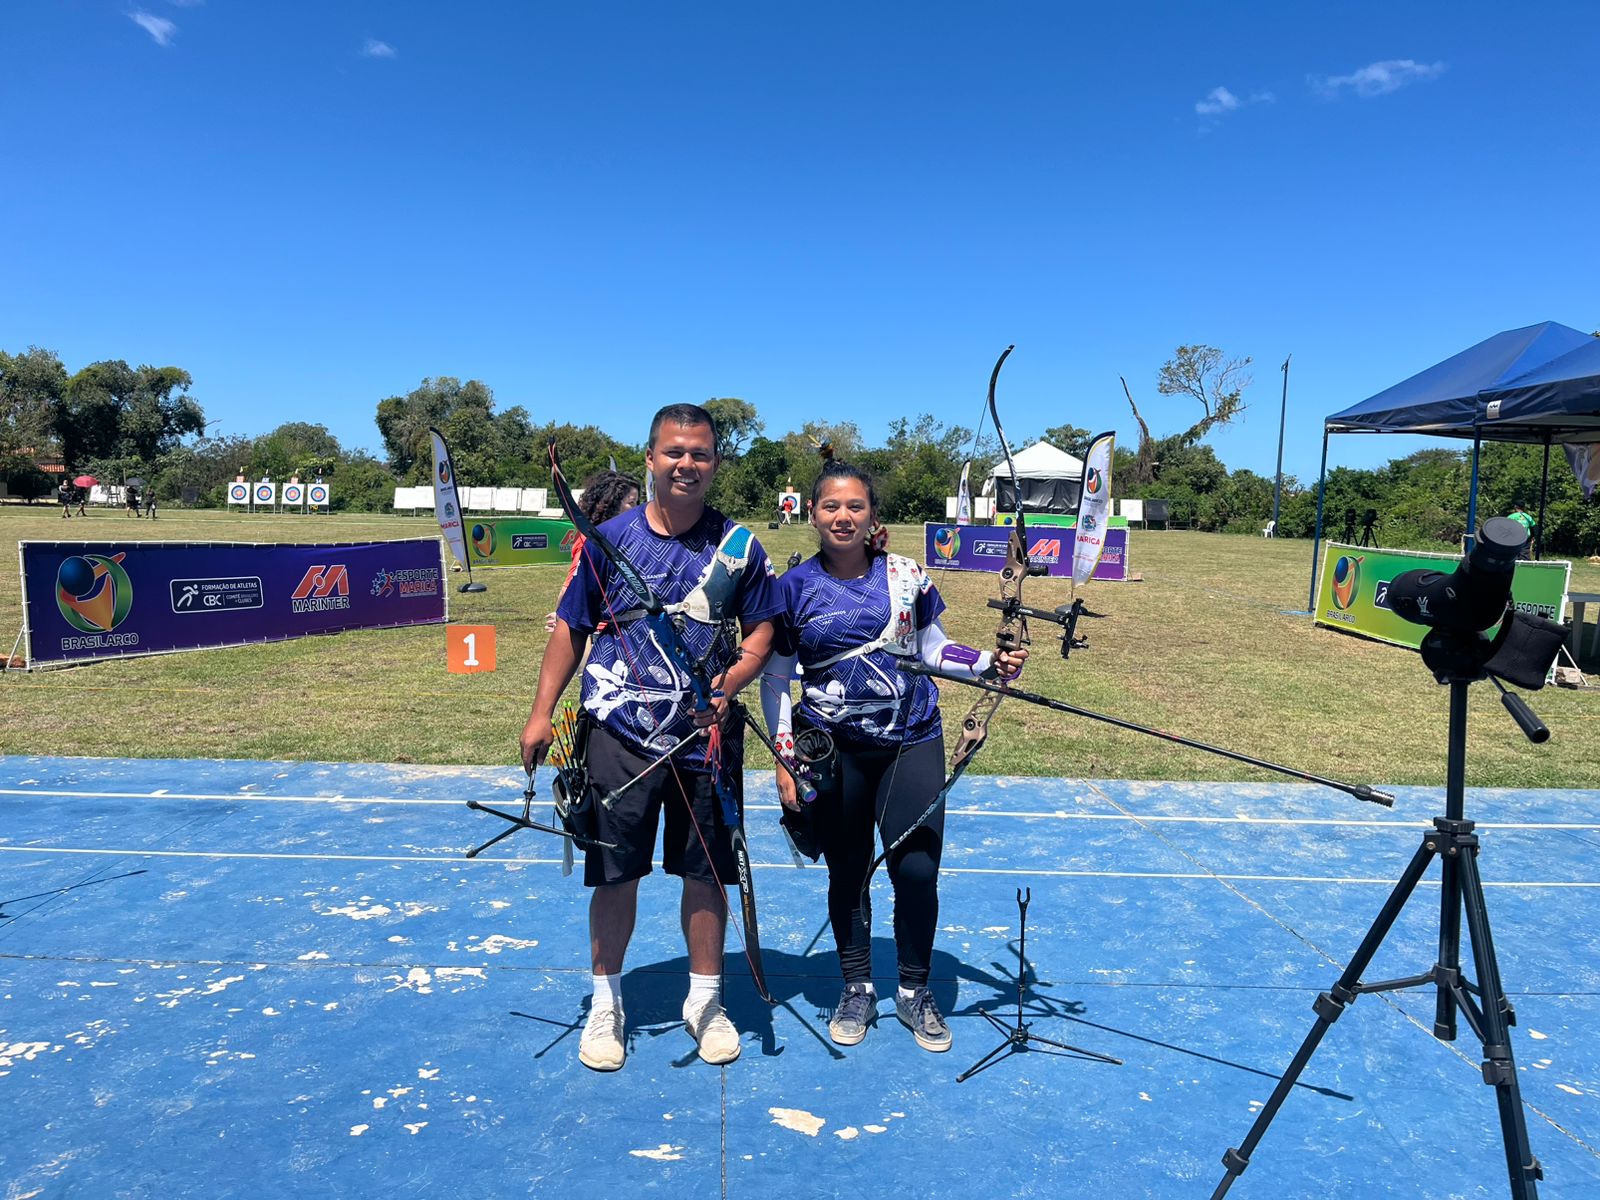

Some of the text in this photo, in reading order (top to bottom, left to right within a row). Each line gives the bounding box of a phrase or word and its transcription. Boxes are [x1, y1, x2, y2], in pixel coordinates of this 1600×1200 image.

[396, 568, 439, 581] ESPORTE
[201, 583, 230, 591] FORMAÇÃO
[203, 594, 222, 606] CBC
[293, 598, 350, 613] MARINTER
[61, 633, 139, 650] BRASILARCO
[463, 633, 479, 666] 1
